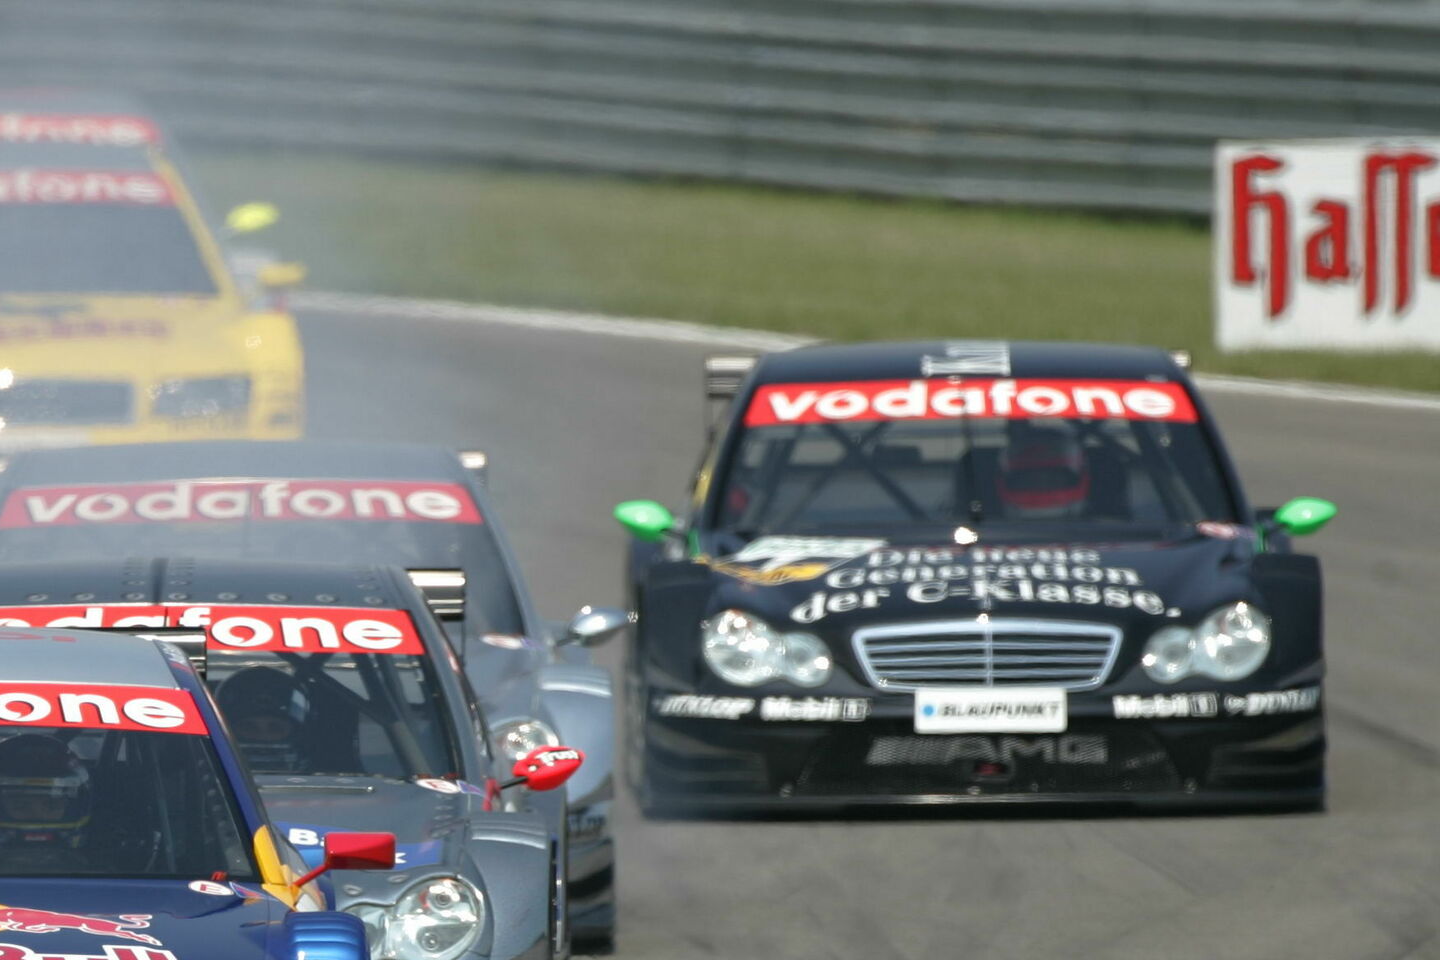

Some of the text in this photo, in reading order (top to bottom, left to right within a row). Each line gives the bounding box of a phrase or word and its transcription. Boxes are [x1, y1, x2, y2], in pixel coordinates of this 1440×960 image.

[769, 380, 1176, 419] vodafone
[25, 479, 462, 523] vodafone
[825, 563, 1141, 588] Generation
[790, 588, 890, 622] der
